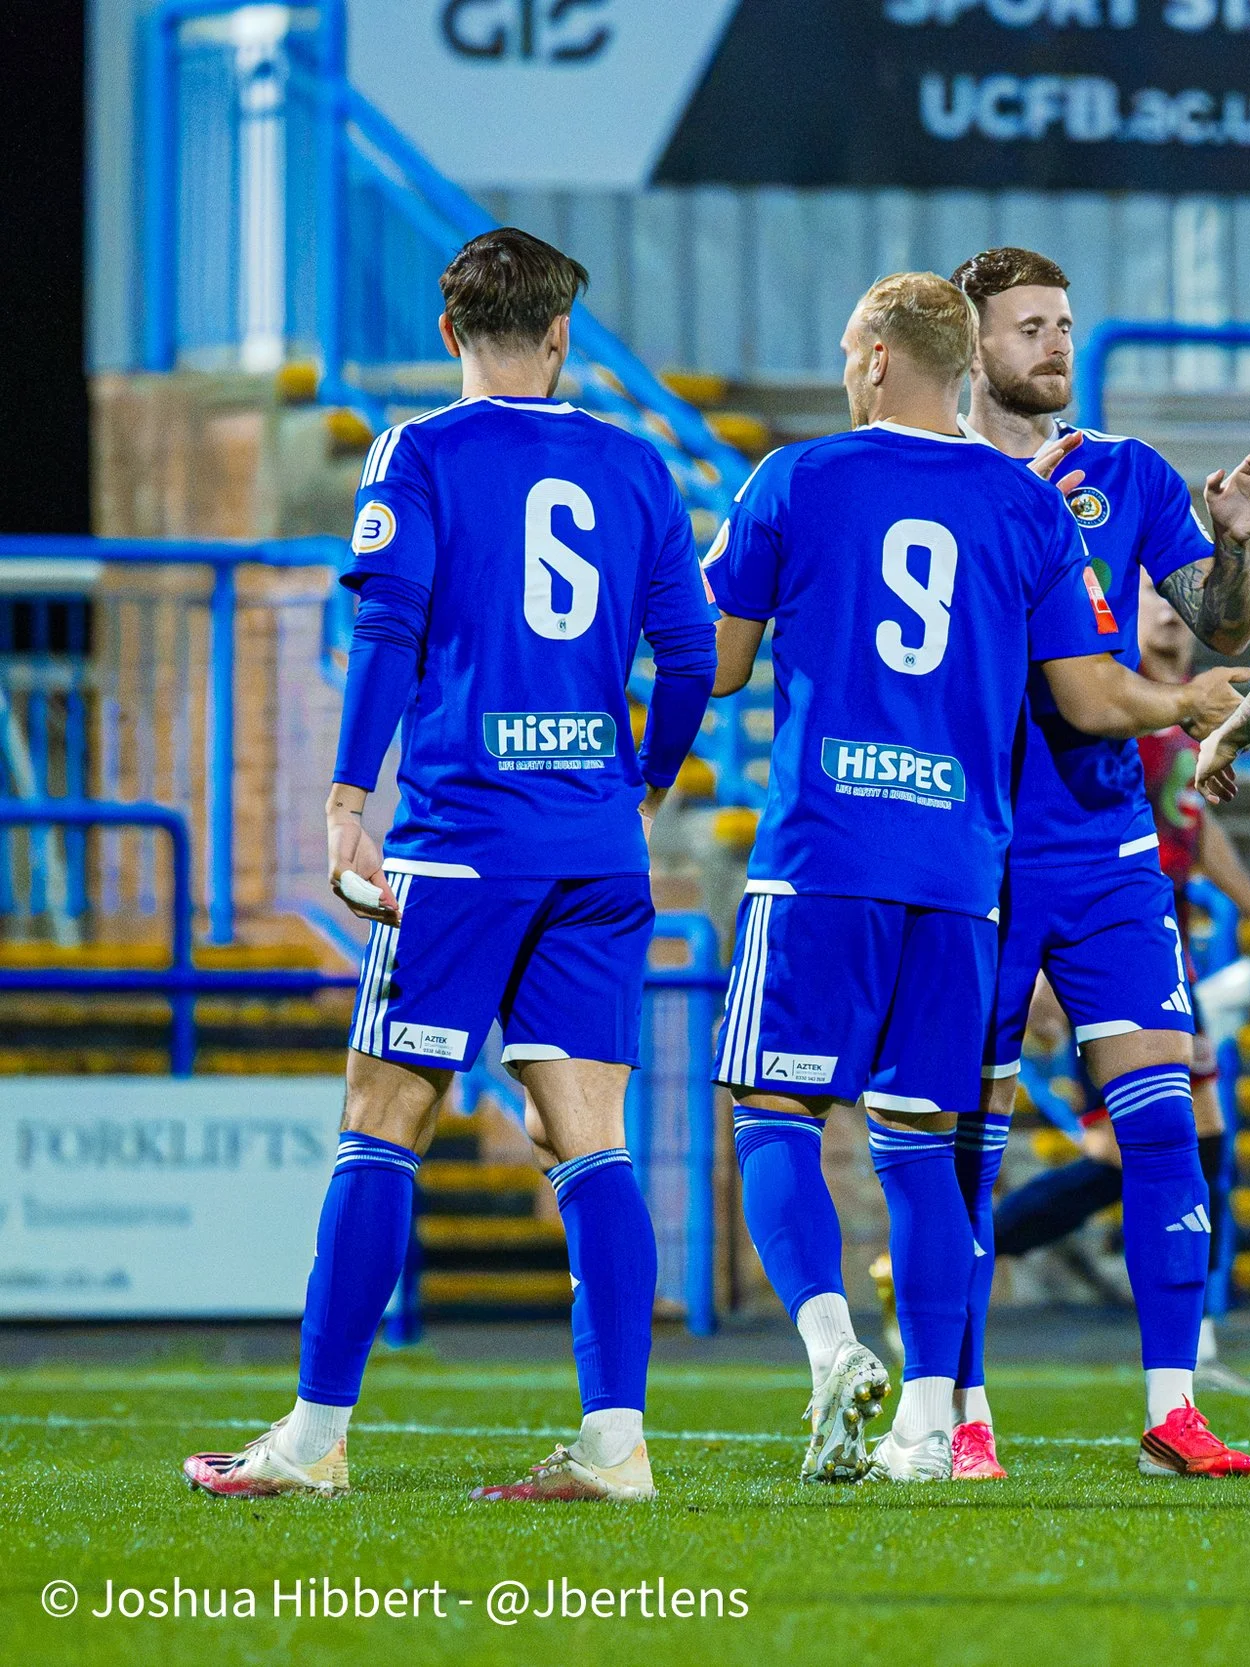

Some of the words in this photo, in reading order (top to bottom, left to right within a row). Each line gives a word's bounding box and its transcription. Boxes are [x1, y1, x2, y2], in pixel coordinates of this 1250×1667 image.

[438, 0, 613, 62] GIS
[524, 478, 600, 640] 6
[876, 519, 957, 675] 9
[424, 1034, 448, 1044] AZTEK
[796, 1063, 822, 1071] AZTEK
